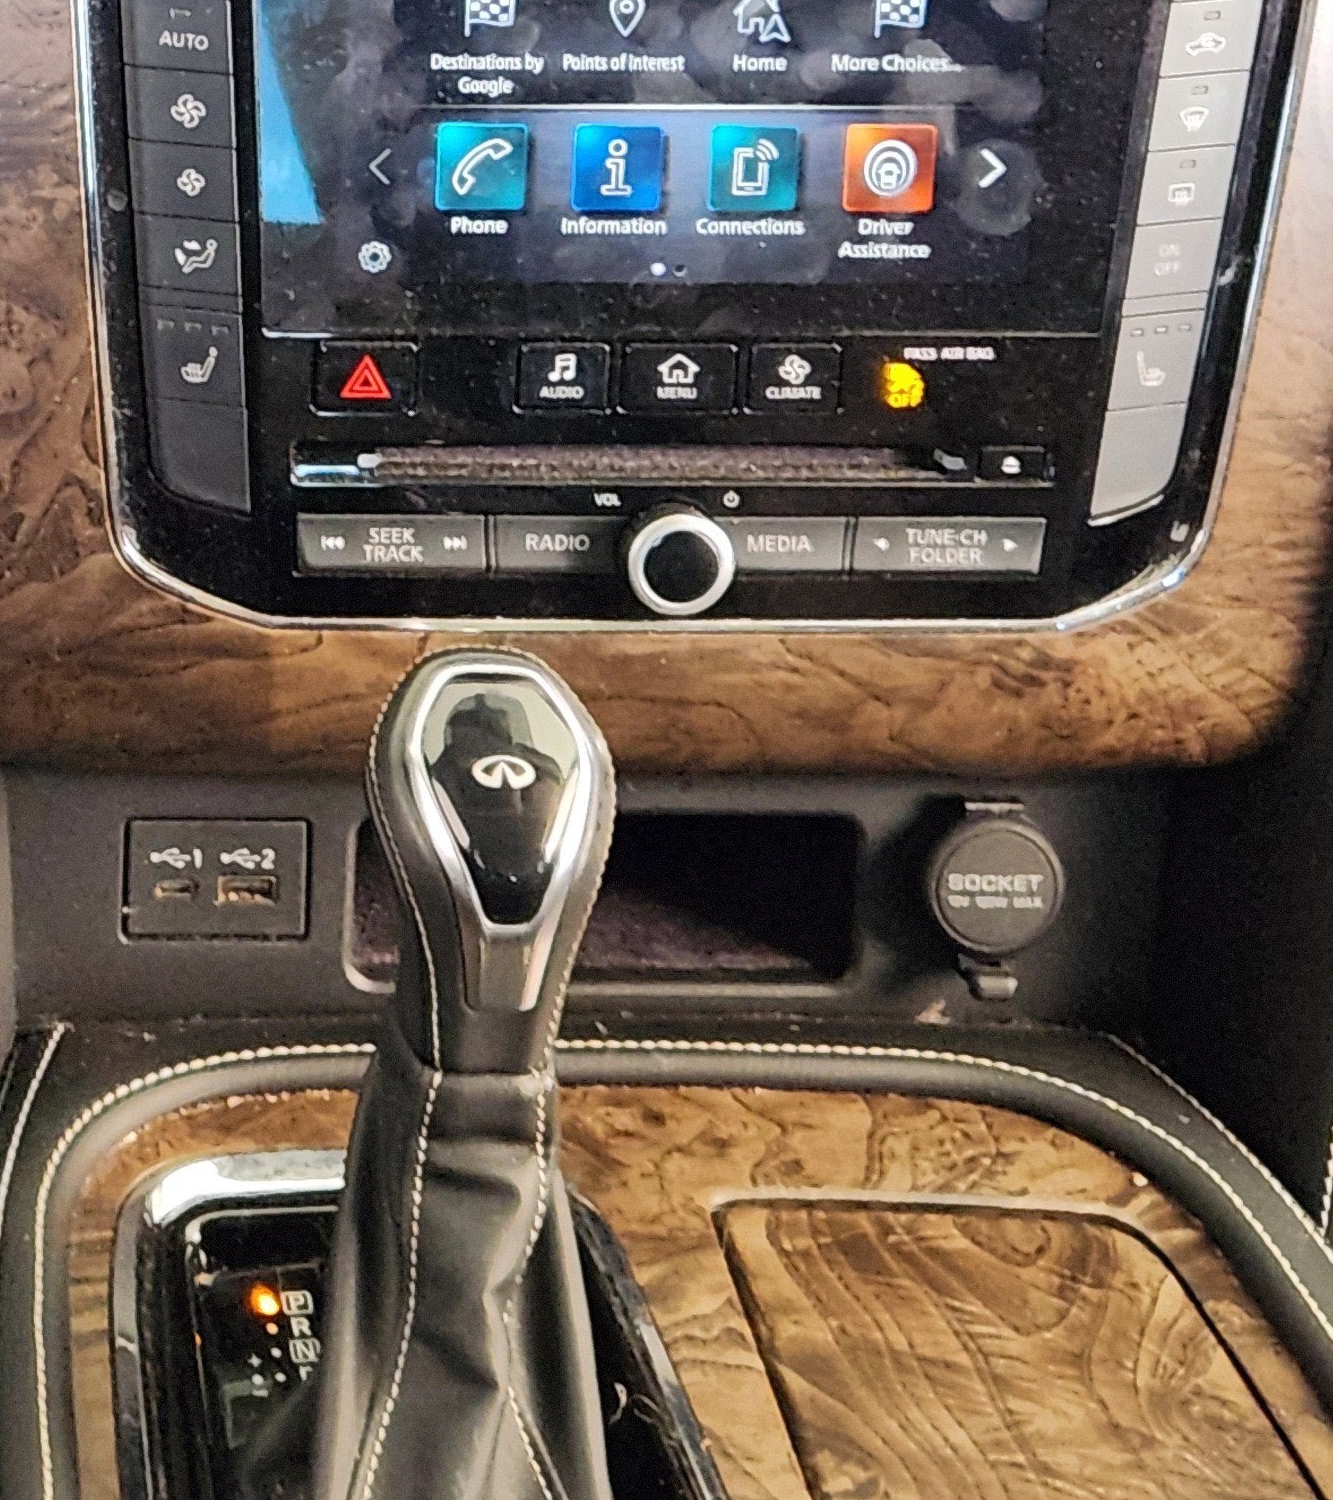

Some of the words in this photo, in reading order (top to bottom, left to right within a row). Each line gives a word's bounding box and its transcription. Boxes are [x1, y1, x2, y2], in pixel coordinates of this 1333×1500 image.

[158, 29, 210, 52] AUTO
[430, 52, 520, 72] Destinations
[523, 52, 544, 76] by
[562, 53, 607, 73] Points
[610, 53, 628, 72] of
[629, 53, 685, 73] Interest
[732, 53, 788, 73] Home
[831, 53, 879, 73] More
[457, 76, 514, 98] Google
[450, 217, 508, 237] Phone
[560, 217, 667, 237] Information
[695, 217, 805, 237] Connections
[857, 216, 913, 237] Driver
[837, 239, 931, 261] Assistance
[940, 347, 965, 361] AIR
[538, 385, 585, 401] AUDIO
[765, 385, 822, 400] CLIMATE
[886, 393, 922, 409] OFF
[592, 492, 622, 507] VOL
[367, 527, 416, 545] SEEK
[524, 532, 590, 553] RADIO
[747, 533, 812, 553] MEDIA
[362, 545, 424, 564] TRACK
[909, 546, 984, 565] FOLDER
[260, 847, 277, 871] 2
[947, 872, 1045, 893] SOCKET
[290, 1316, 312, 1338] R
